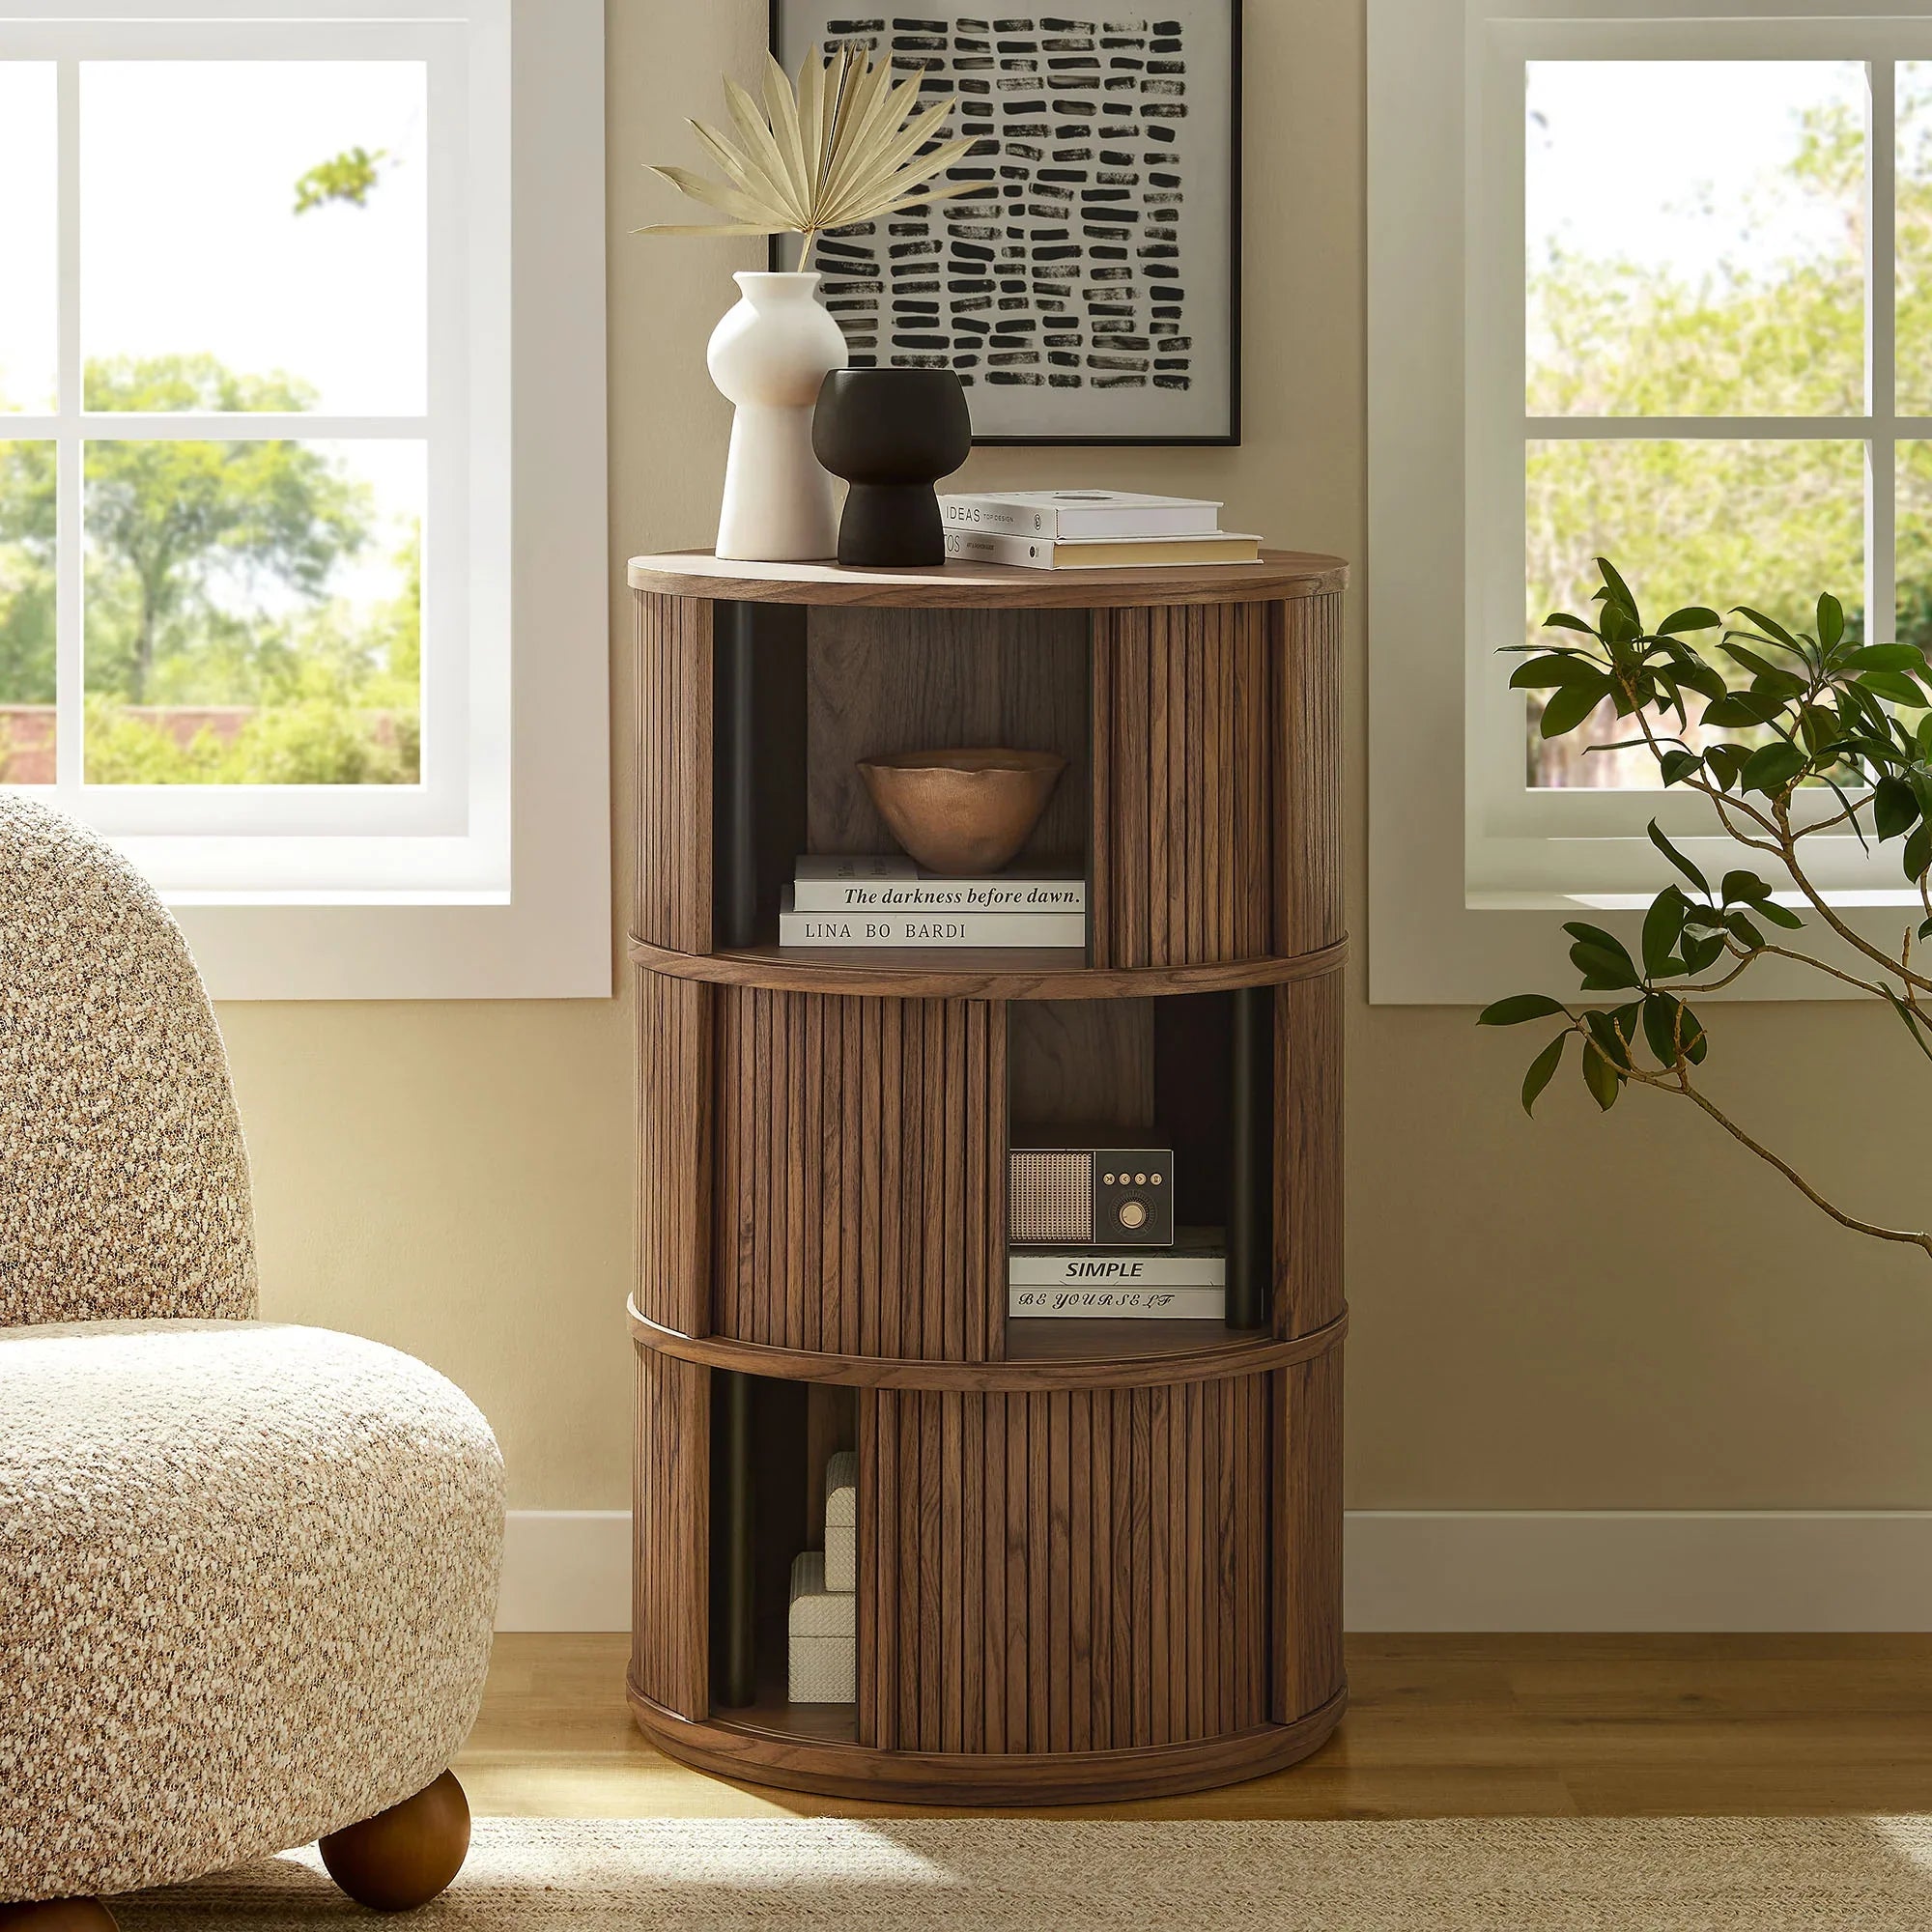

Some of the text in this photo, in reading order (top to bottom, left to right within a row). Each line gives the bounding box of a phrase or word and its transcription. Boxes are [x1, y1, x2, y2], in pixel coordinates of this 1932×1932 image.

[946, 505, 980, 523] IDEAS
[995, 514, 1014, 523] DESIGN
[844, 887, 1081, 906] The darkness before dawn.
[805, 923, 966, 938] LINA BO BARDI
[1065, 1262, 1144, 1277] SIMPLE
[1018, 1293, 1176, 1310] BE YOURSELF
